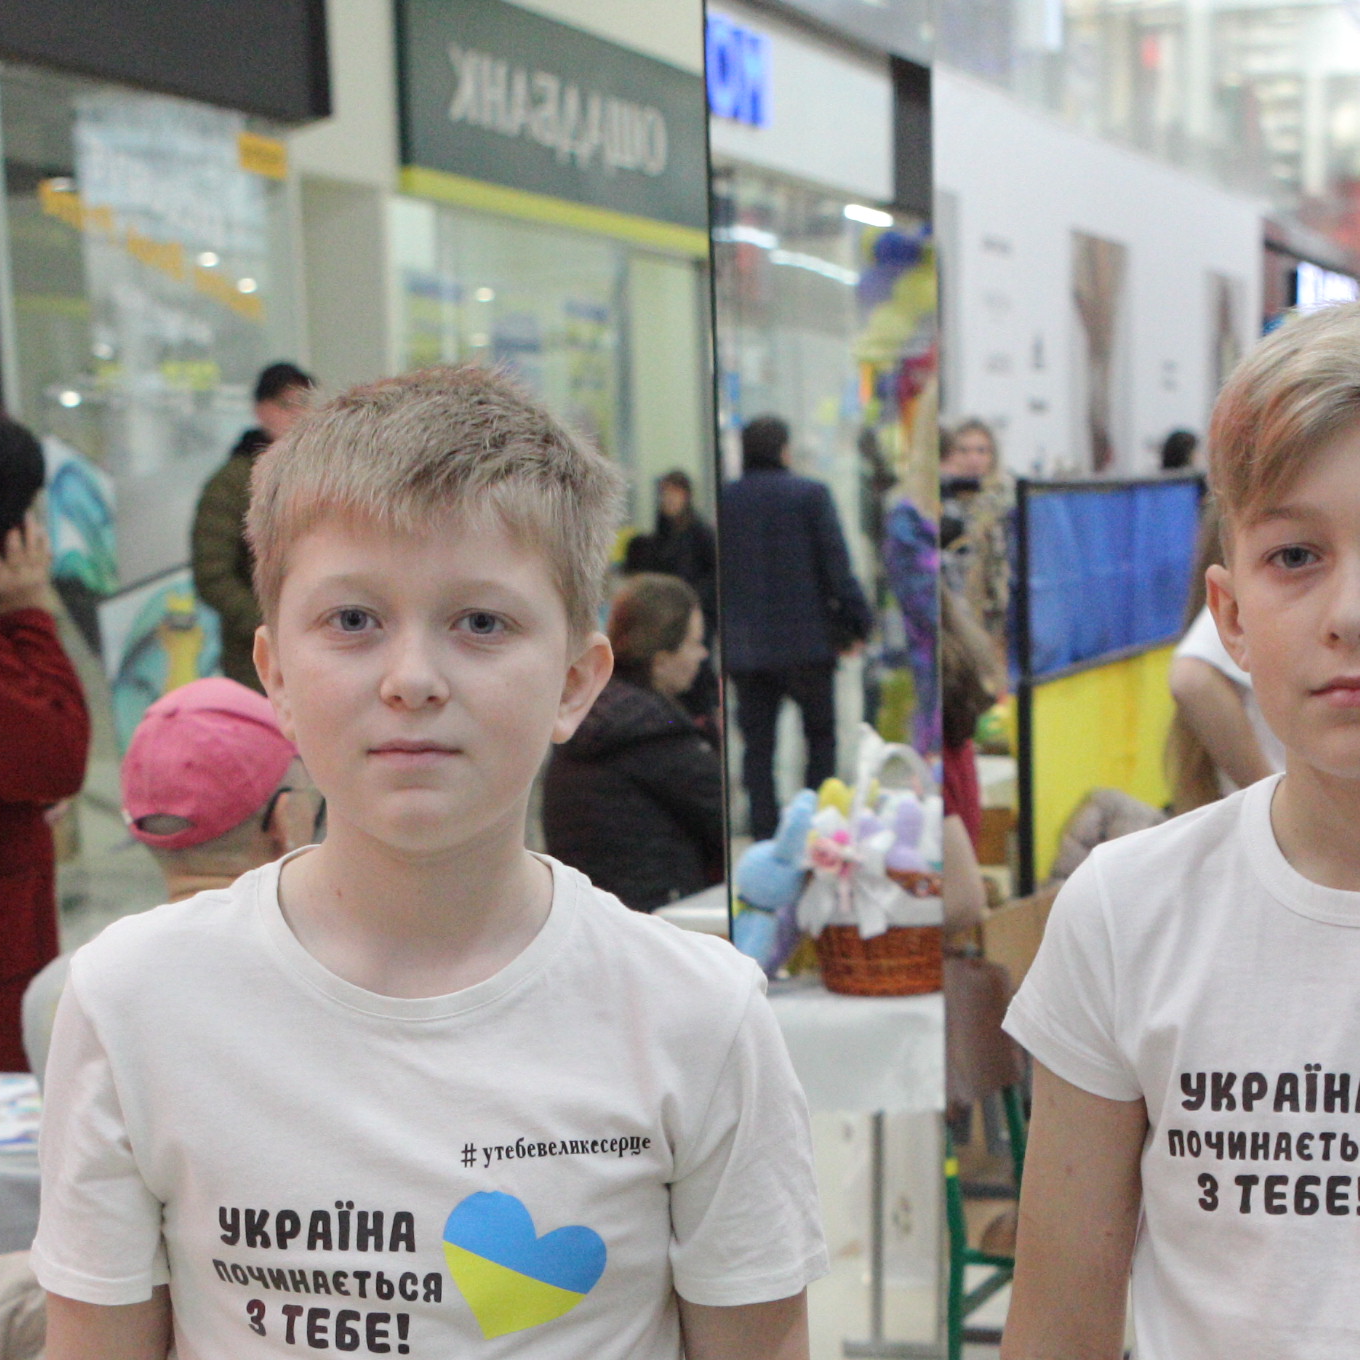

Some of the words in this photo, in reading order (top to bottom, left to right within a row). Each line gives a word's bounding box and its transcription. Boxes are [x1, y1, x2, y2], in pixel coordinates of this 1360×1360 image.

[460, 1134, 652, 1169] #утебевеликесерце
[1197, 1172, 1220, 1212] З
[217, 1200, 417, 1254] УКРАЇНА
[211, 1258, 443, 1304] ПОЧИНАЄТЬСЯ
[246, 1298, 268, 1338] З
[281, 1304, 411, 1356] ТЕБЕ!
